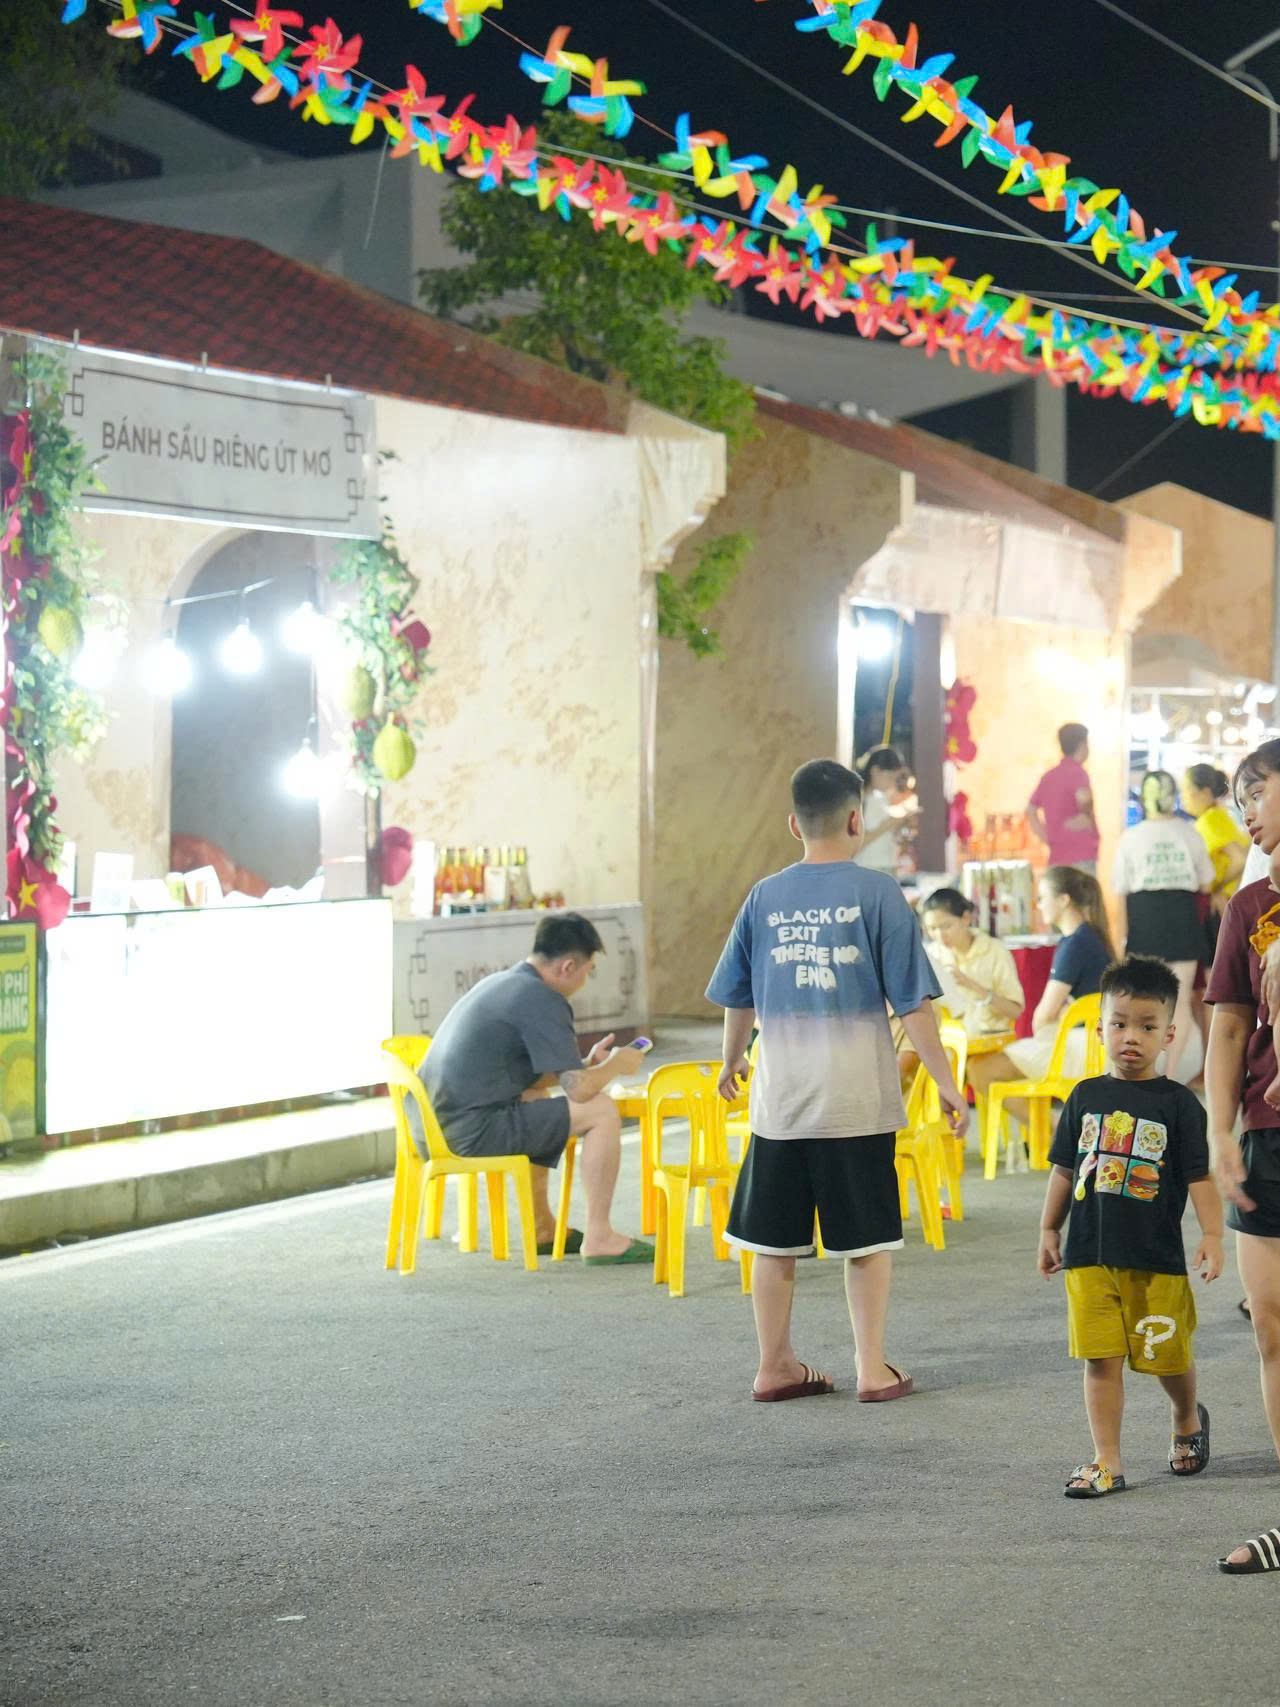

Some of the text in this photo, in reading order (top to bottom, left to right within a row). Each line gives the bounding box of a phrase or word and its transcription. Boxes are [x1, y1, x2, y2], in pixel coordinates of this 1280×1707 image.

[102, 415, 162, 457] BÁNH
[214, 434, 270, 471] RIÊNG
[275, 439, 298, 474] ÚT
[767, 907, 833, 928] BLACK
[777, 926, 820, 943] EXIT
[770, 943, 830, 966] THERE
[795, 964, 837, 991] END
